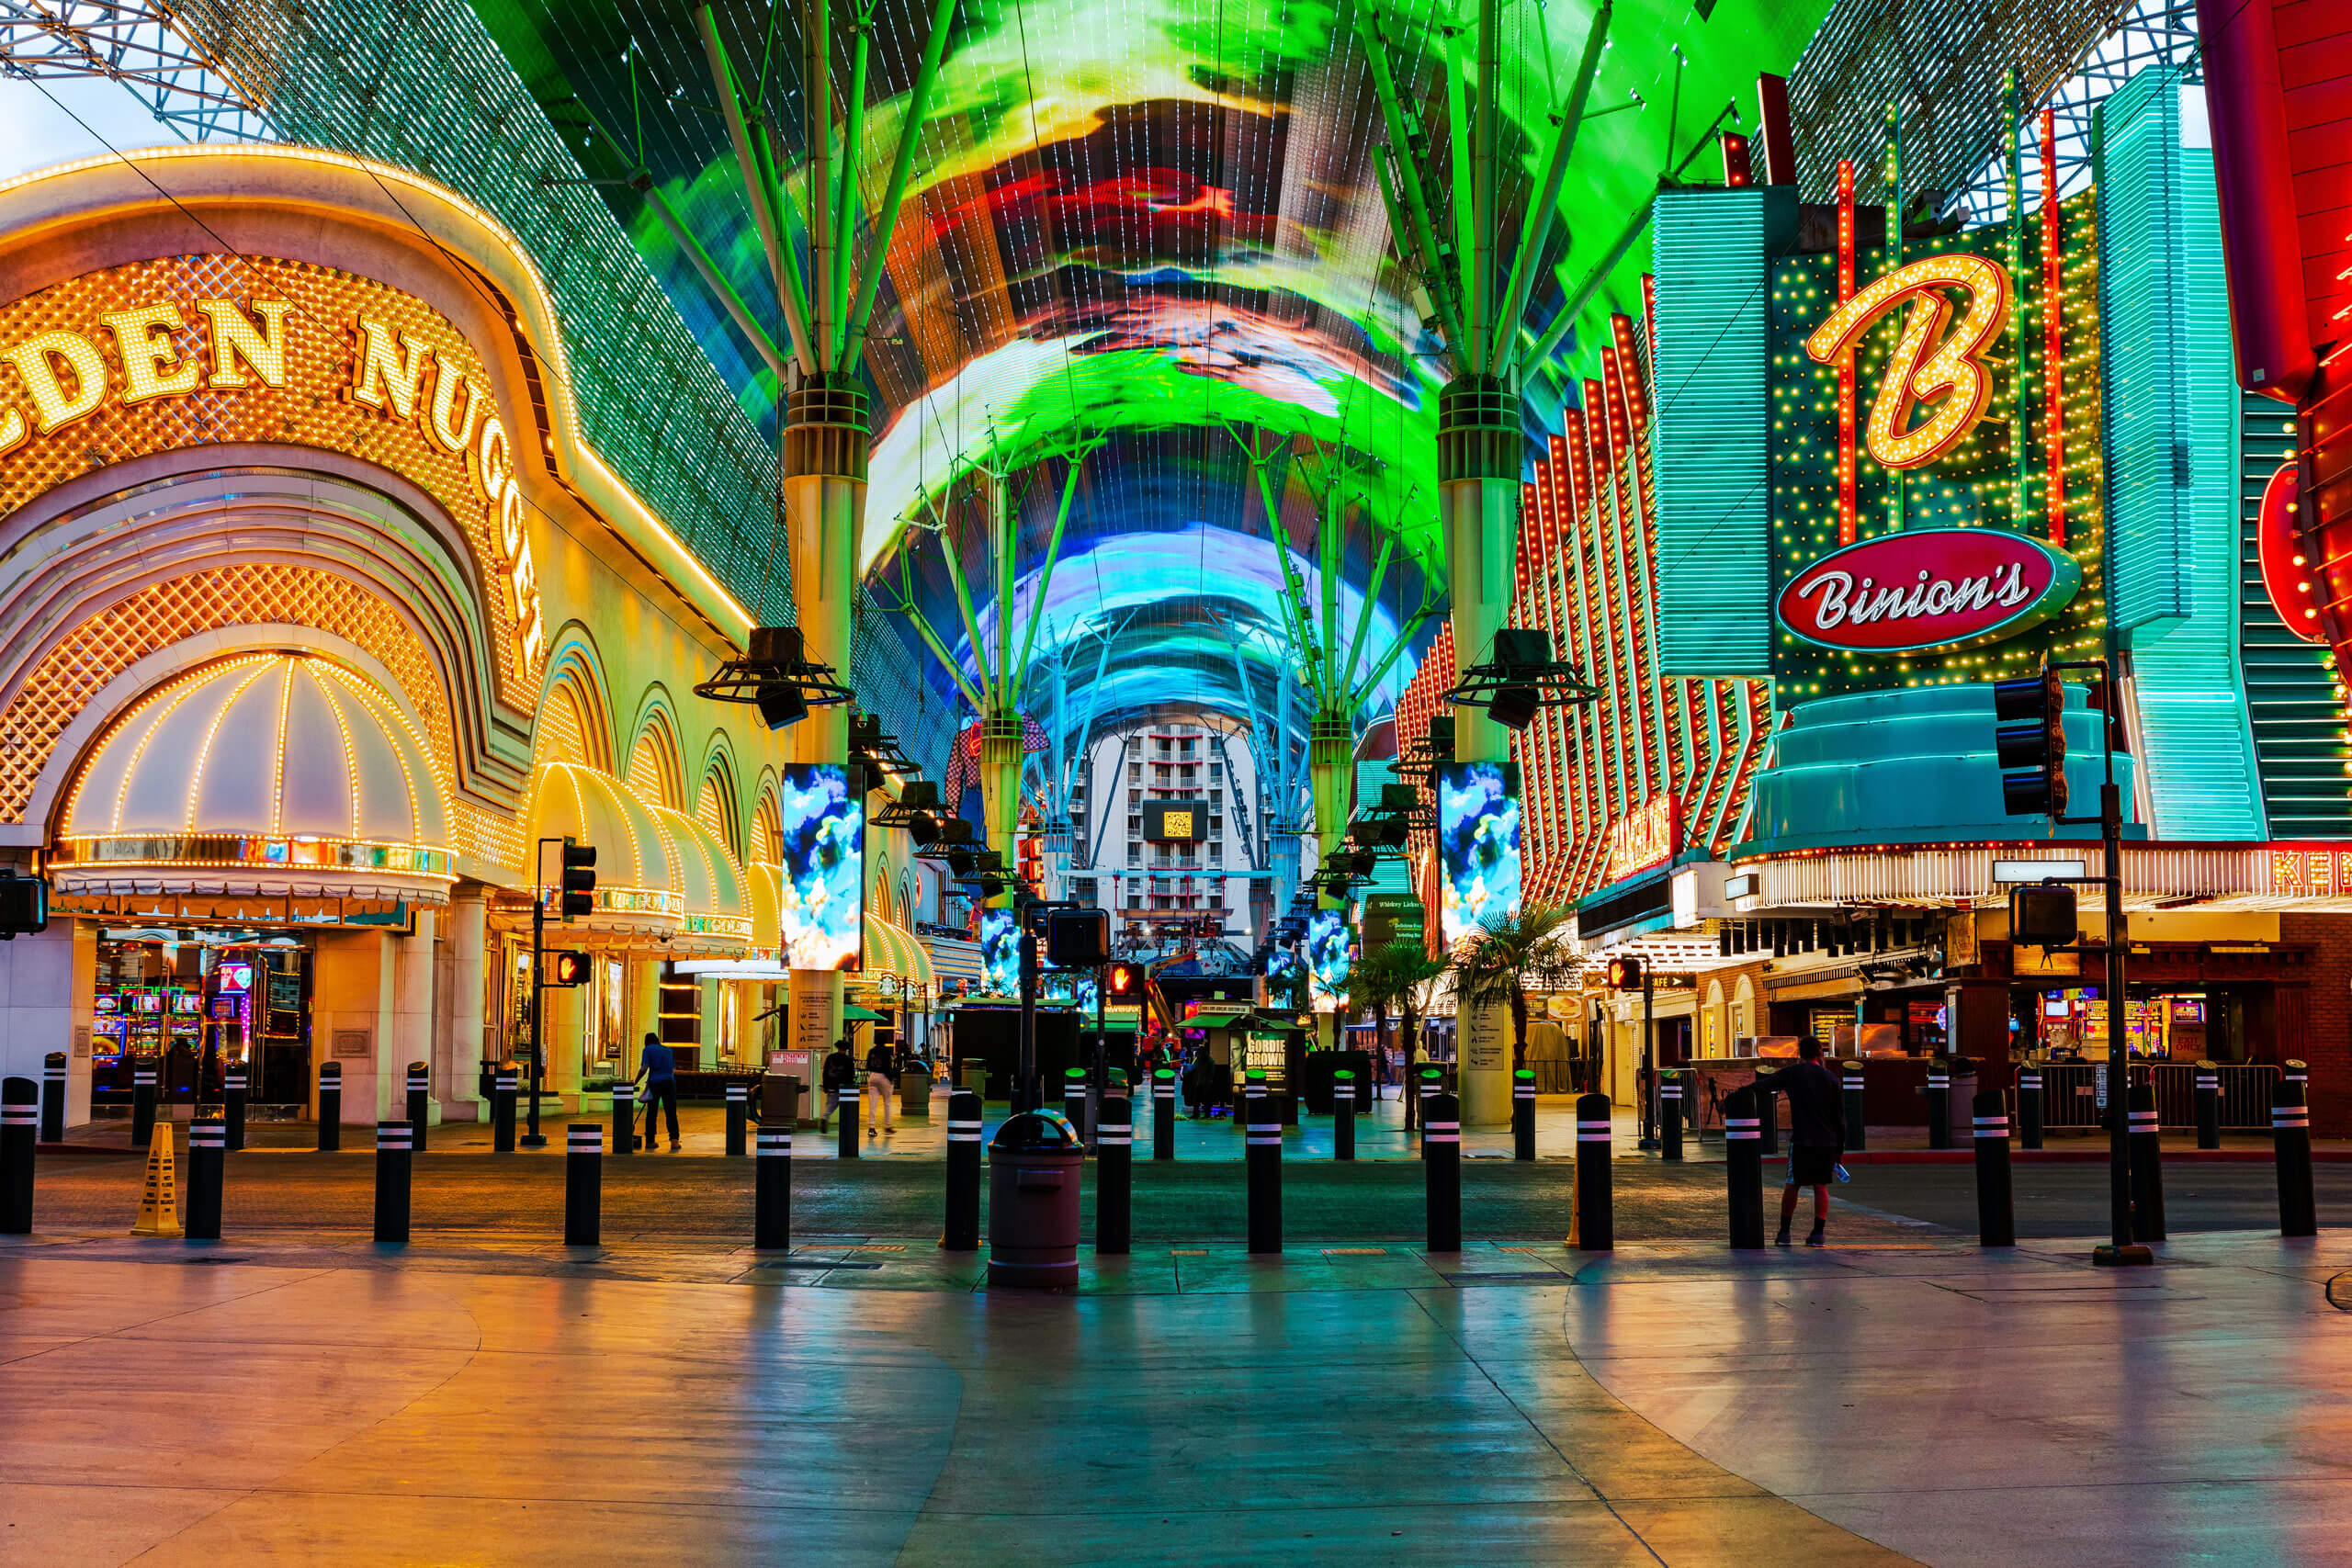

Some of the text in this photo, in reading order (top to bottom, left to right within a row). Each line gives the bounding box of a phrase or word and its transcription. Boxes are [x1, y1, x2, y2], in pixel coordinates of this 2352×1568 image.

[1806, 254, 2014, 470] B
[0, 298, 547, 680] DEN NUGGET
[1799, 561, 2030, 632] Binion's
[1247, 1053, 1285, 1066] BROWN
[1248, 1039, 1285, 1052] GORDIE
[2177, 1036, 2199, 1044] EXIT
